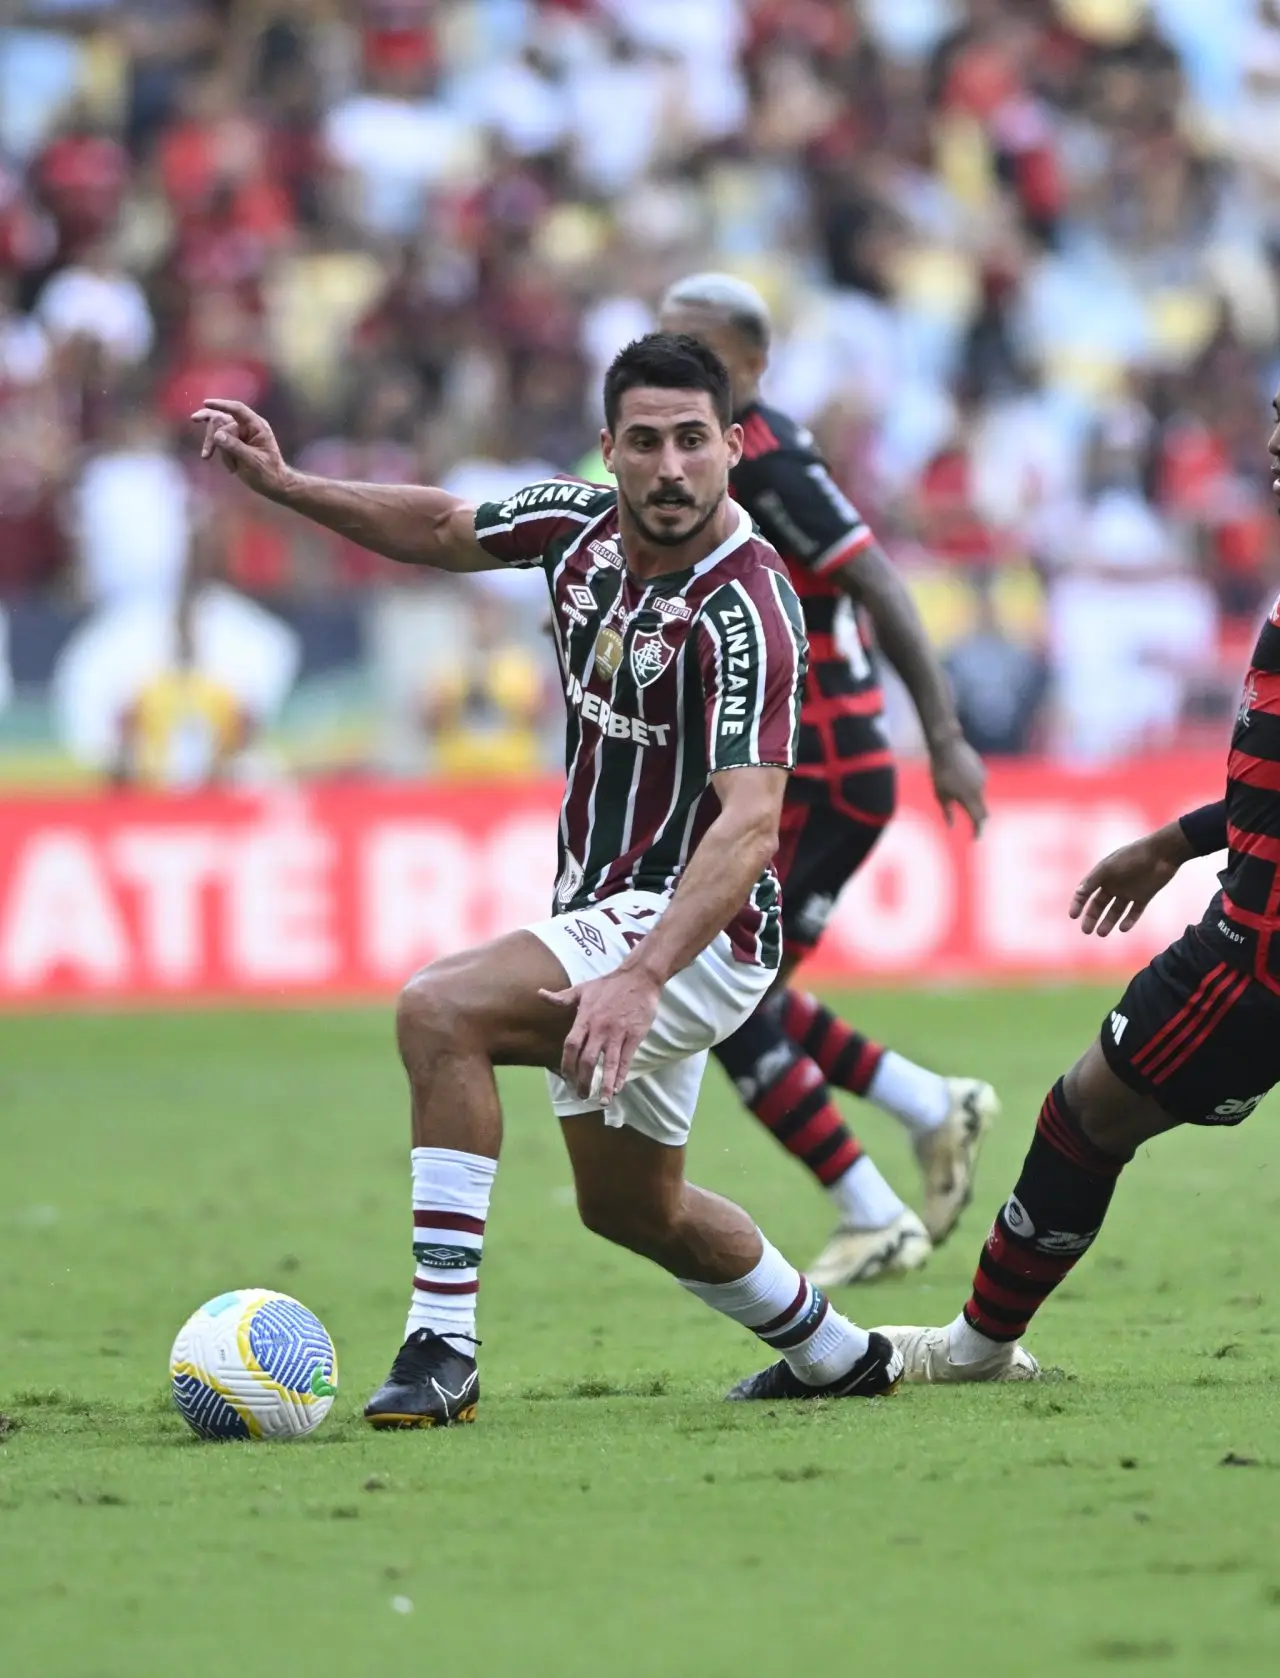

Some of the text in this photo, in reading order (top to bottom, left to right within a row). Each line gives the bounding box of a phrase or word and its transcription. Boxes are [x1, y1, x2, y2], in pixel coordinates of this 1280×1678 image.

[499, 485, 595, 518] ZINZANE
[589, 541, 622, 568] FRESCATTO
[561, 602, 588, 626] umbro
[655, 599, 691, 618] FRESCATTO
[719, 604, 750, 736] ZINZANE
[5, 790, 341, 984] ATÉ
[564, 926, 592, 956] umbro
[1214, 1092, 1266, 1115] ab
